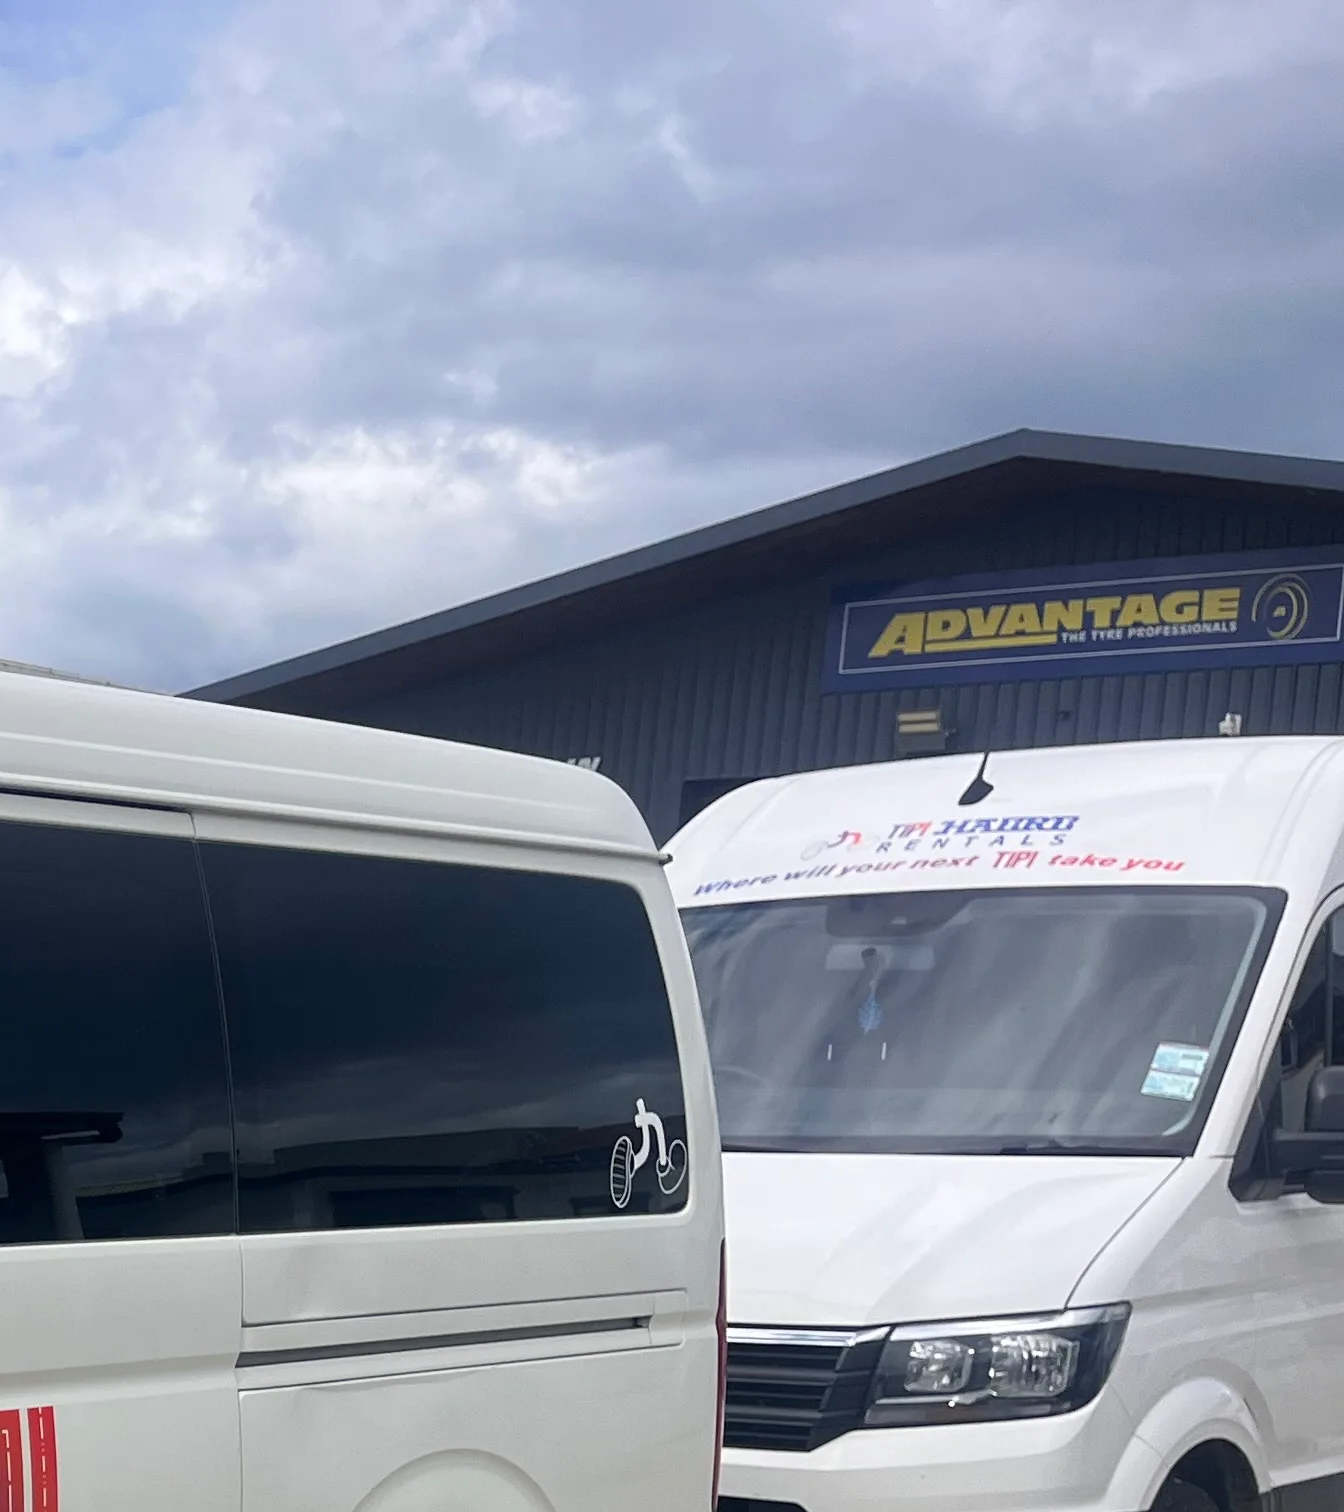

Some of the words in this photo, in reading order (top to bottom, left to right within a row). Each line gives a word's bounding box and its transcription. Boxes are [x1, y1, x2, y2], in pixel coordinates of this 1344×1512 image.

[868, 588, 1243, 658] ADVANTAGE
[1062, 629, 1087, 645] THE
[1091, 626, 1122, 642] TYRE
[1128, 620, 1238, 640] PROFESSIONALS
[887, 820, 932, 839] TIPI
[876, 833, 1067, 853] RENTALS
[693, 873, 778, 896] Where
[784, 863, 838, 881] will
[835, 860, 907, 878] your
[909, 854, 981, 871] next
[992, 851, 1040, 869] TIPI
[1049, 853, 1118, 868] take
[1119, 857, 1186, 872] you
